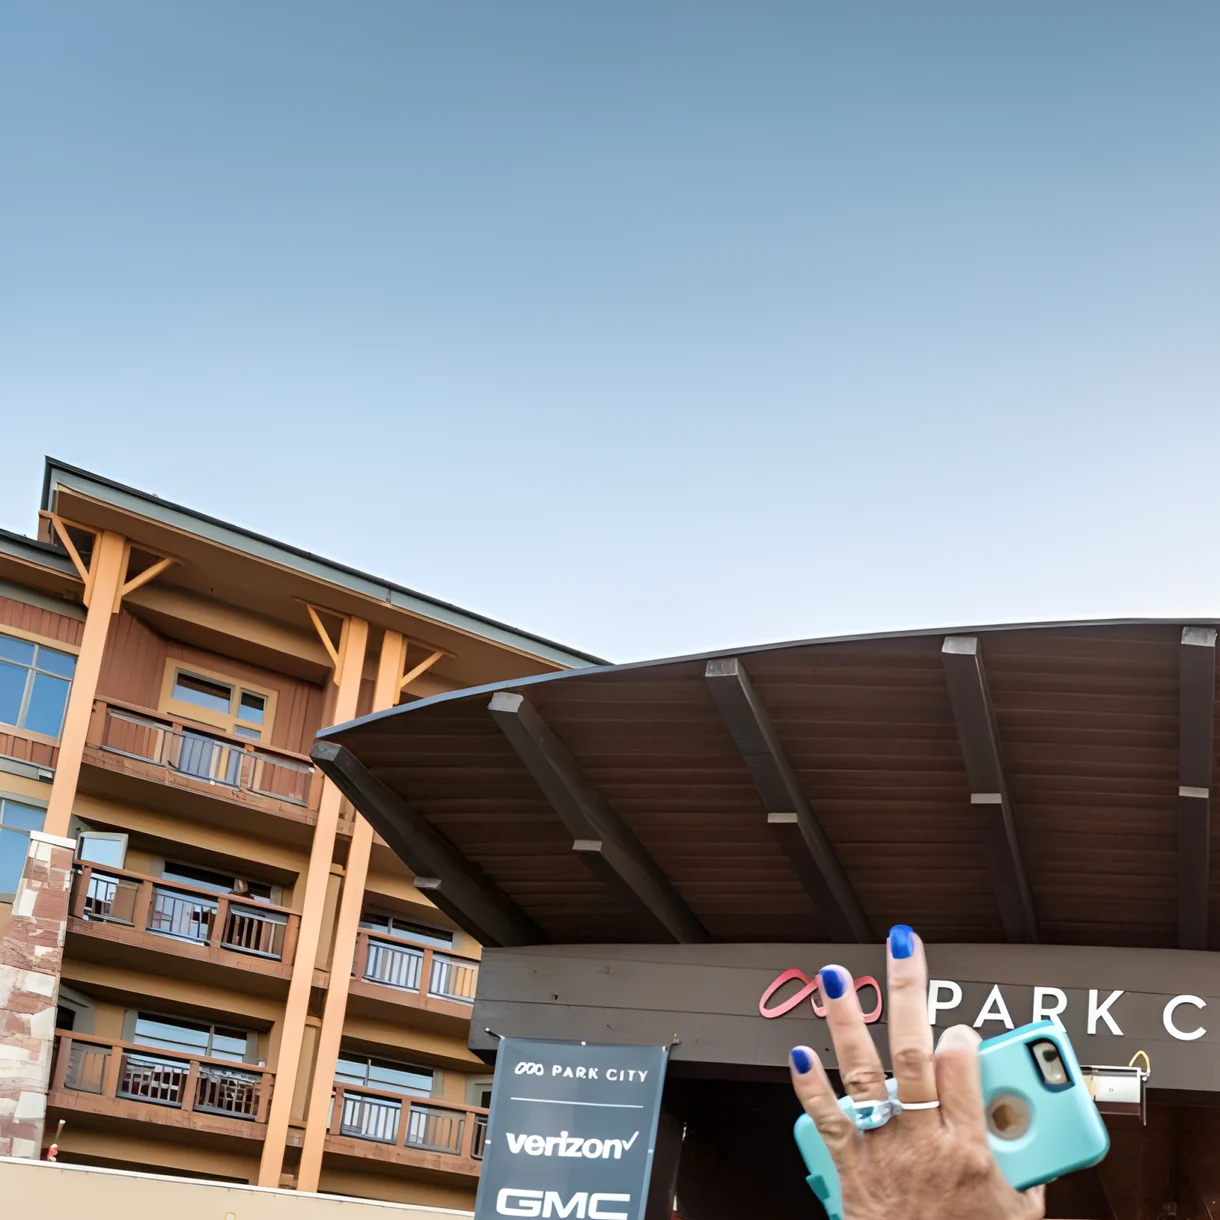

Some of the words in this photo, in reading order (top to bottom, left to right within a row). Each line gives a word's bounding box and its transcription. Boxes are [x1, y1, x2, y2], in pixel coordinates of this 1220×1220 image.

[928, 979, 1124, 1036] PARK
[552, 1064, 599, 1080] PARK
[606, 1068, 649, 1083] CITY
[506, 1130, 624, 1161] verizon
[496, 1188, 631, 1220] GMC
